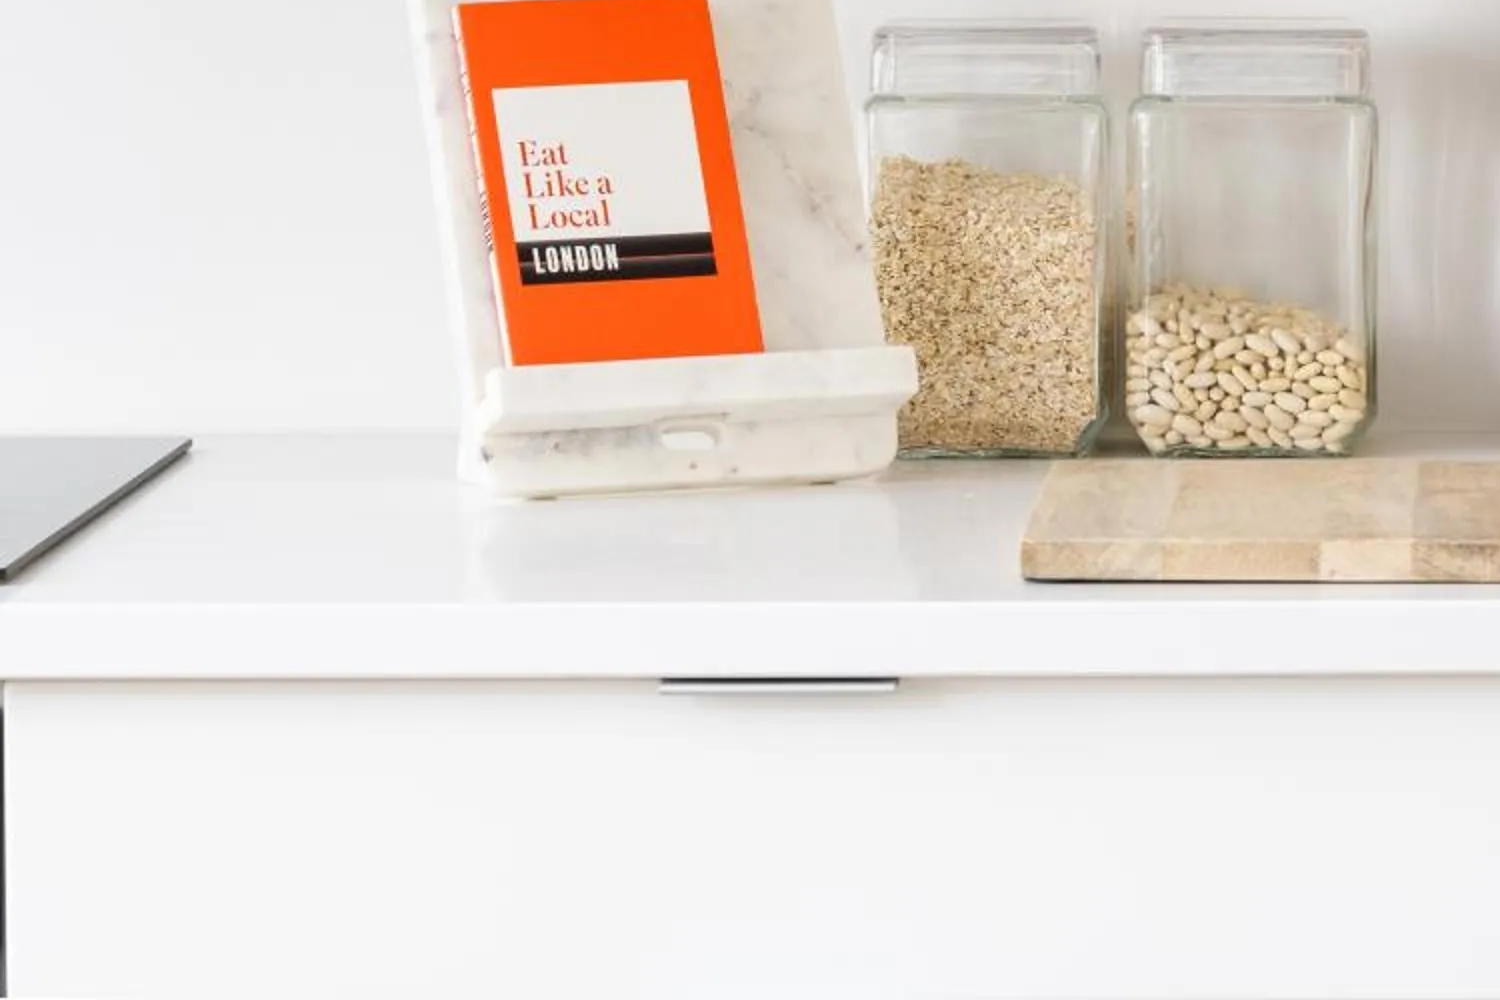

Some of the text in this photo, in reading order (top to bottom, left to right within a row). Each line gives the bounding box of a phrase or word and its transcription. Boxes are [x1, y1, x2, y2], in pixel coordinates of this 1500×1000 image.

[517, 139, 569, 169] Eat
[523, 171, 614, 199] Like a
[528, 200, 612, 231] Local
[531, 243, 620, 275] LONDON
